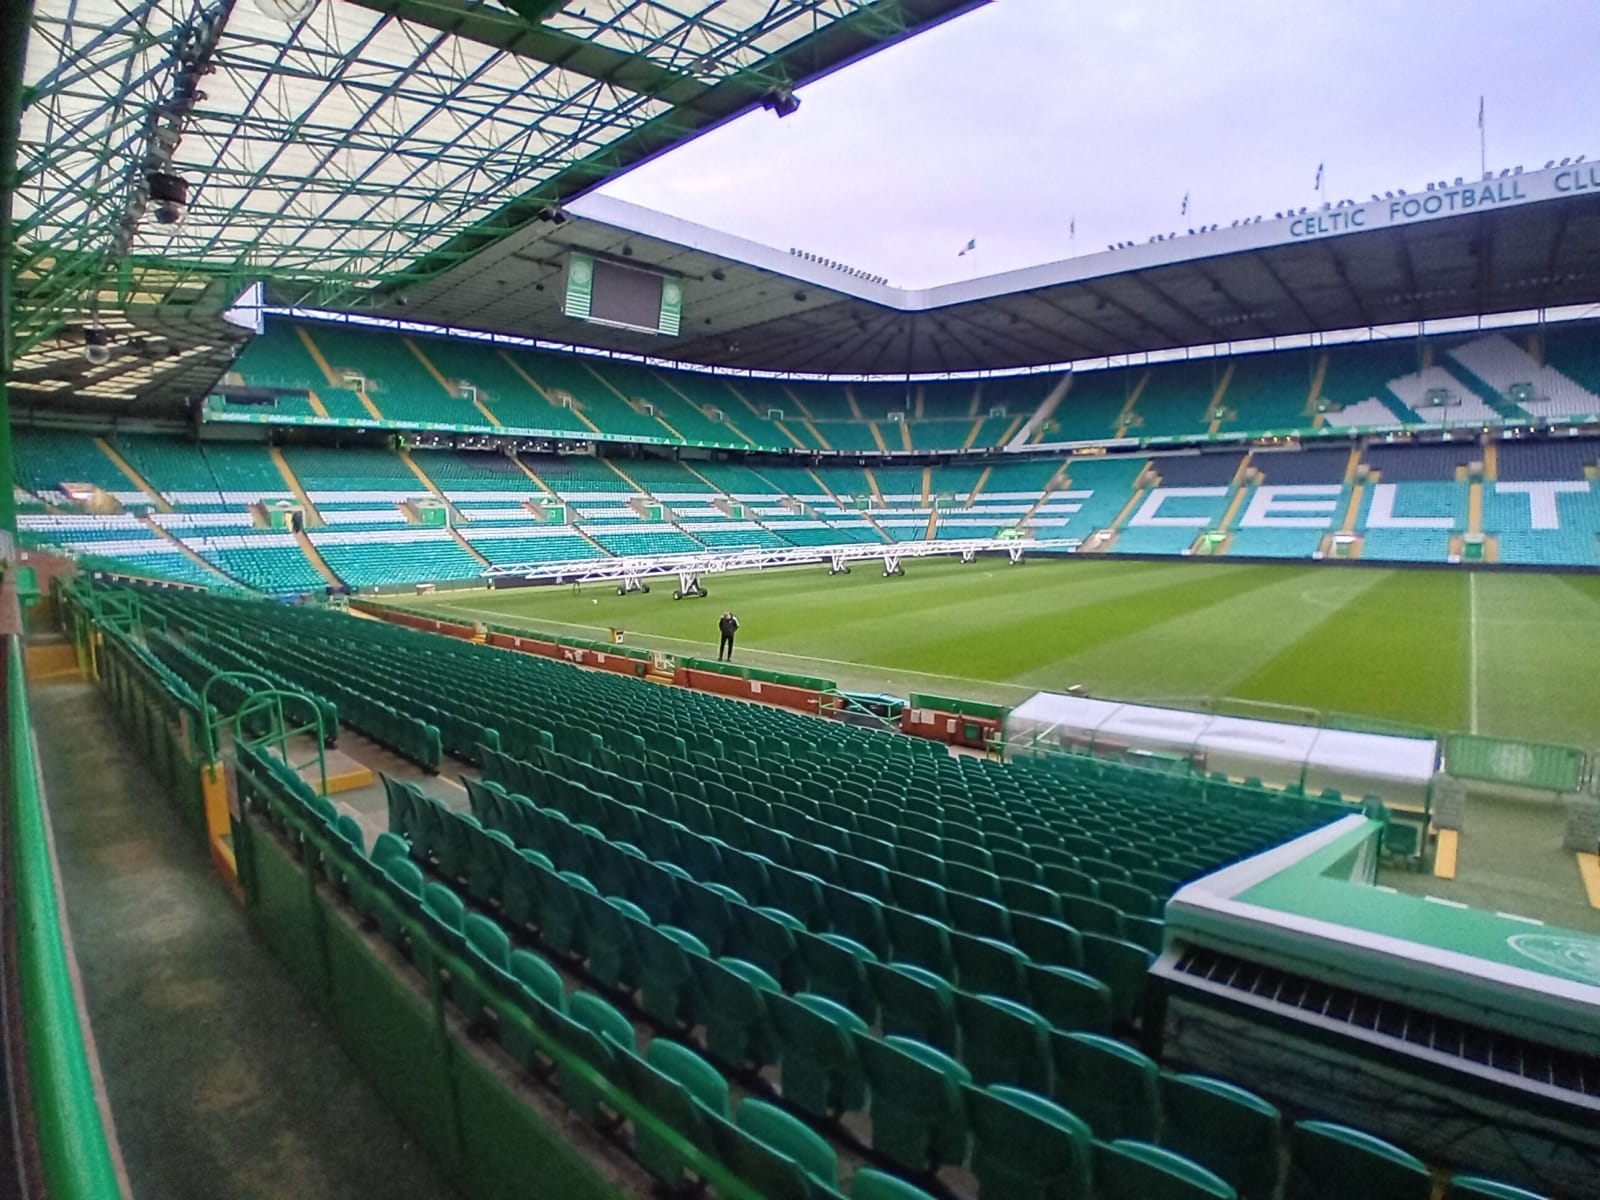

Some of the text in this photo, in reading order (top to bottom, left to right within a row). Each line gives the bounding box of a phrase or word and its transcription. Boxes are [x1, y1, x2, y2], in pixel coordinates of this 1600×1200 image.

[1290, 208, 1365, 237] CELTIC
[1389, 181, 1526, 221] FOOTBALL
[1127, 480, 1591, 530] CELT
